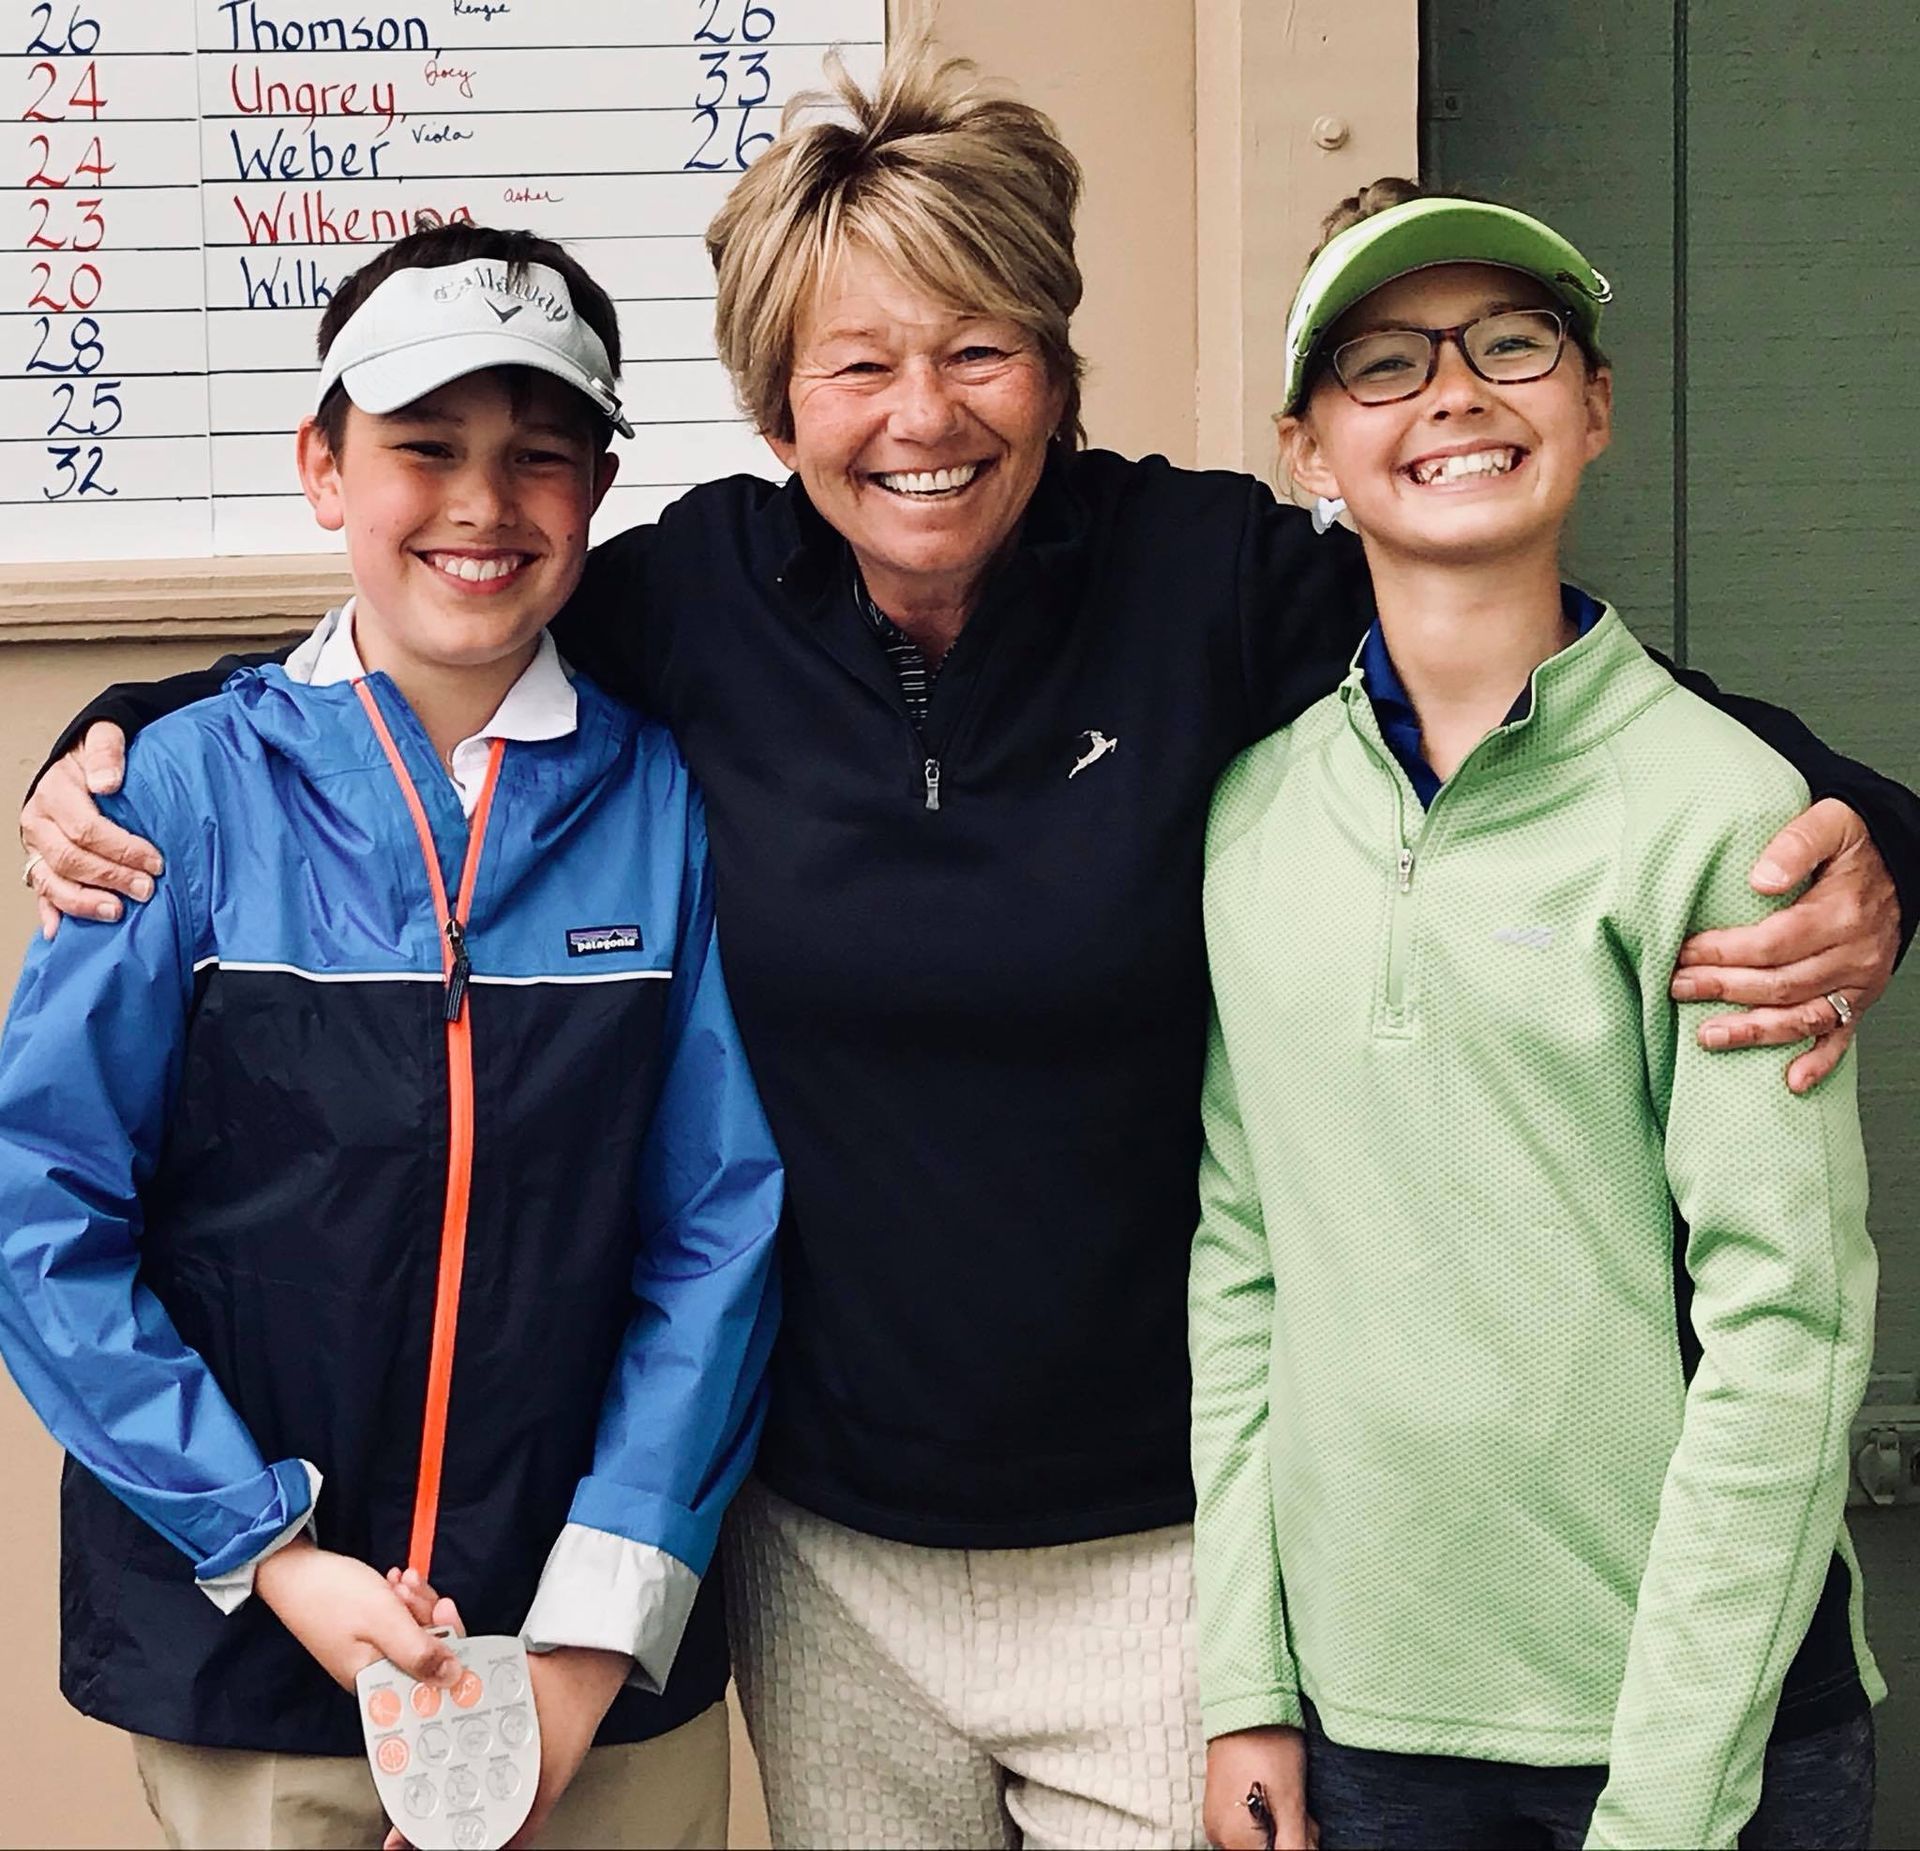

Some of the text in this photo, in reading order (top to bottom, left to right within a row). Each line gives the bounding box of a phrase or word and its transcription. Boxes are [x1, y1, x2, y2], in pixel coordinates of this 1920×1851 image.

[27, 3, 101, 55] 26
[694, 0, 775, 43] 26
[22, 61, 108, 122] 24
[696, 51, 771, 108] 33
[26, 135, 116, 188] 24
[683, 105, 775, 170] 26
[27, 198, 105, 252] 23
[28, 262, 102, 311] 20
[240, 256, 334, 308] Wilk
[26, 317, 104, 374] 28
[47, 381, 122, 435] 25
[43, 446, 118, 501] 32
